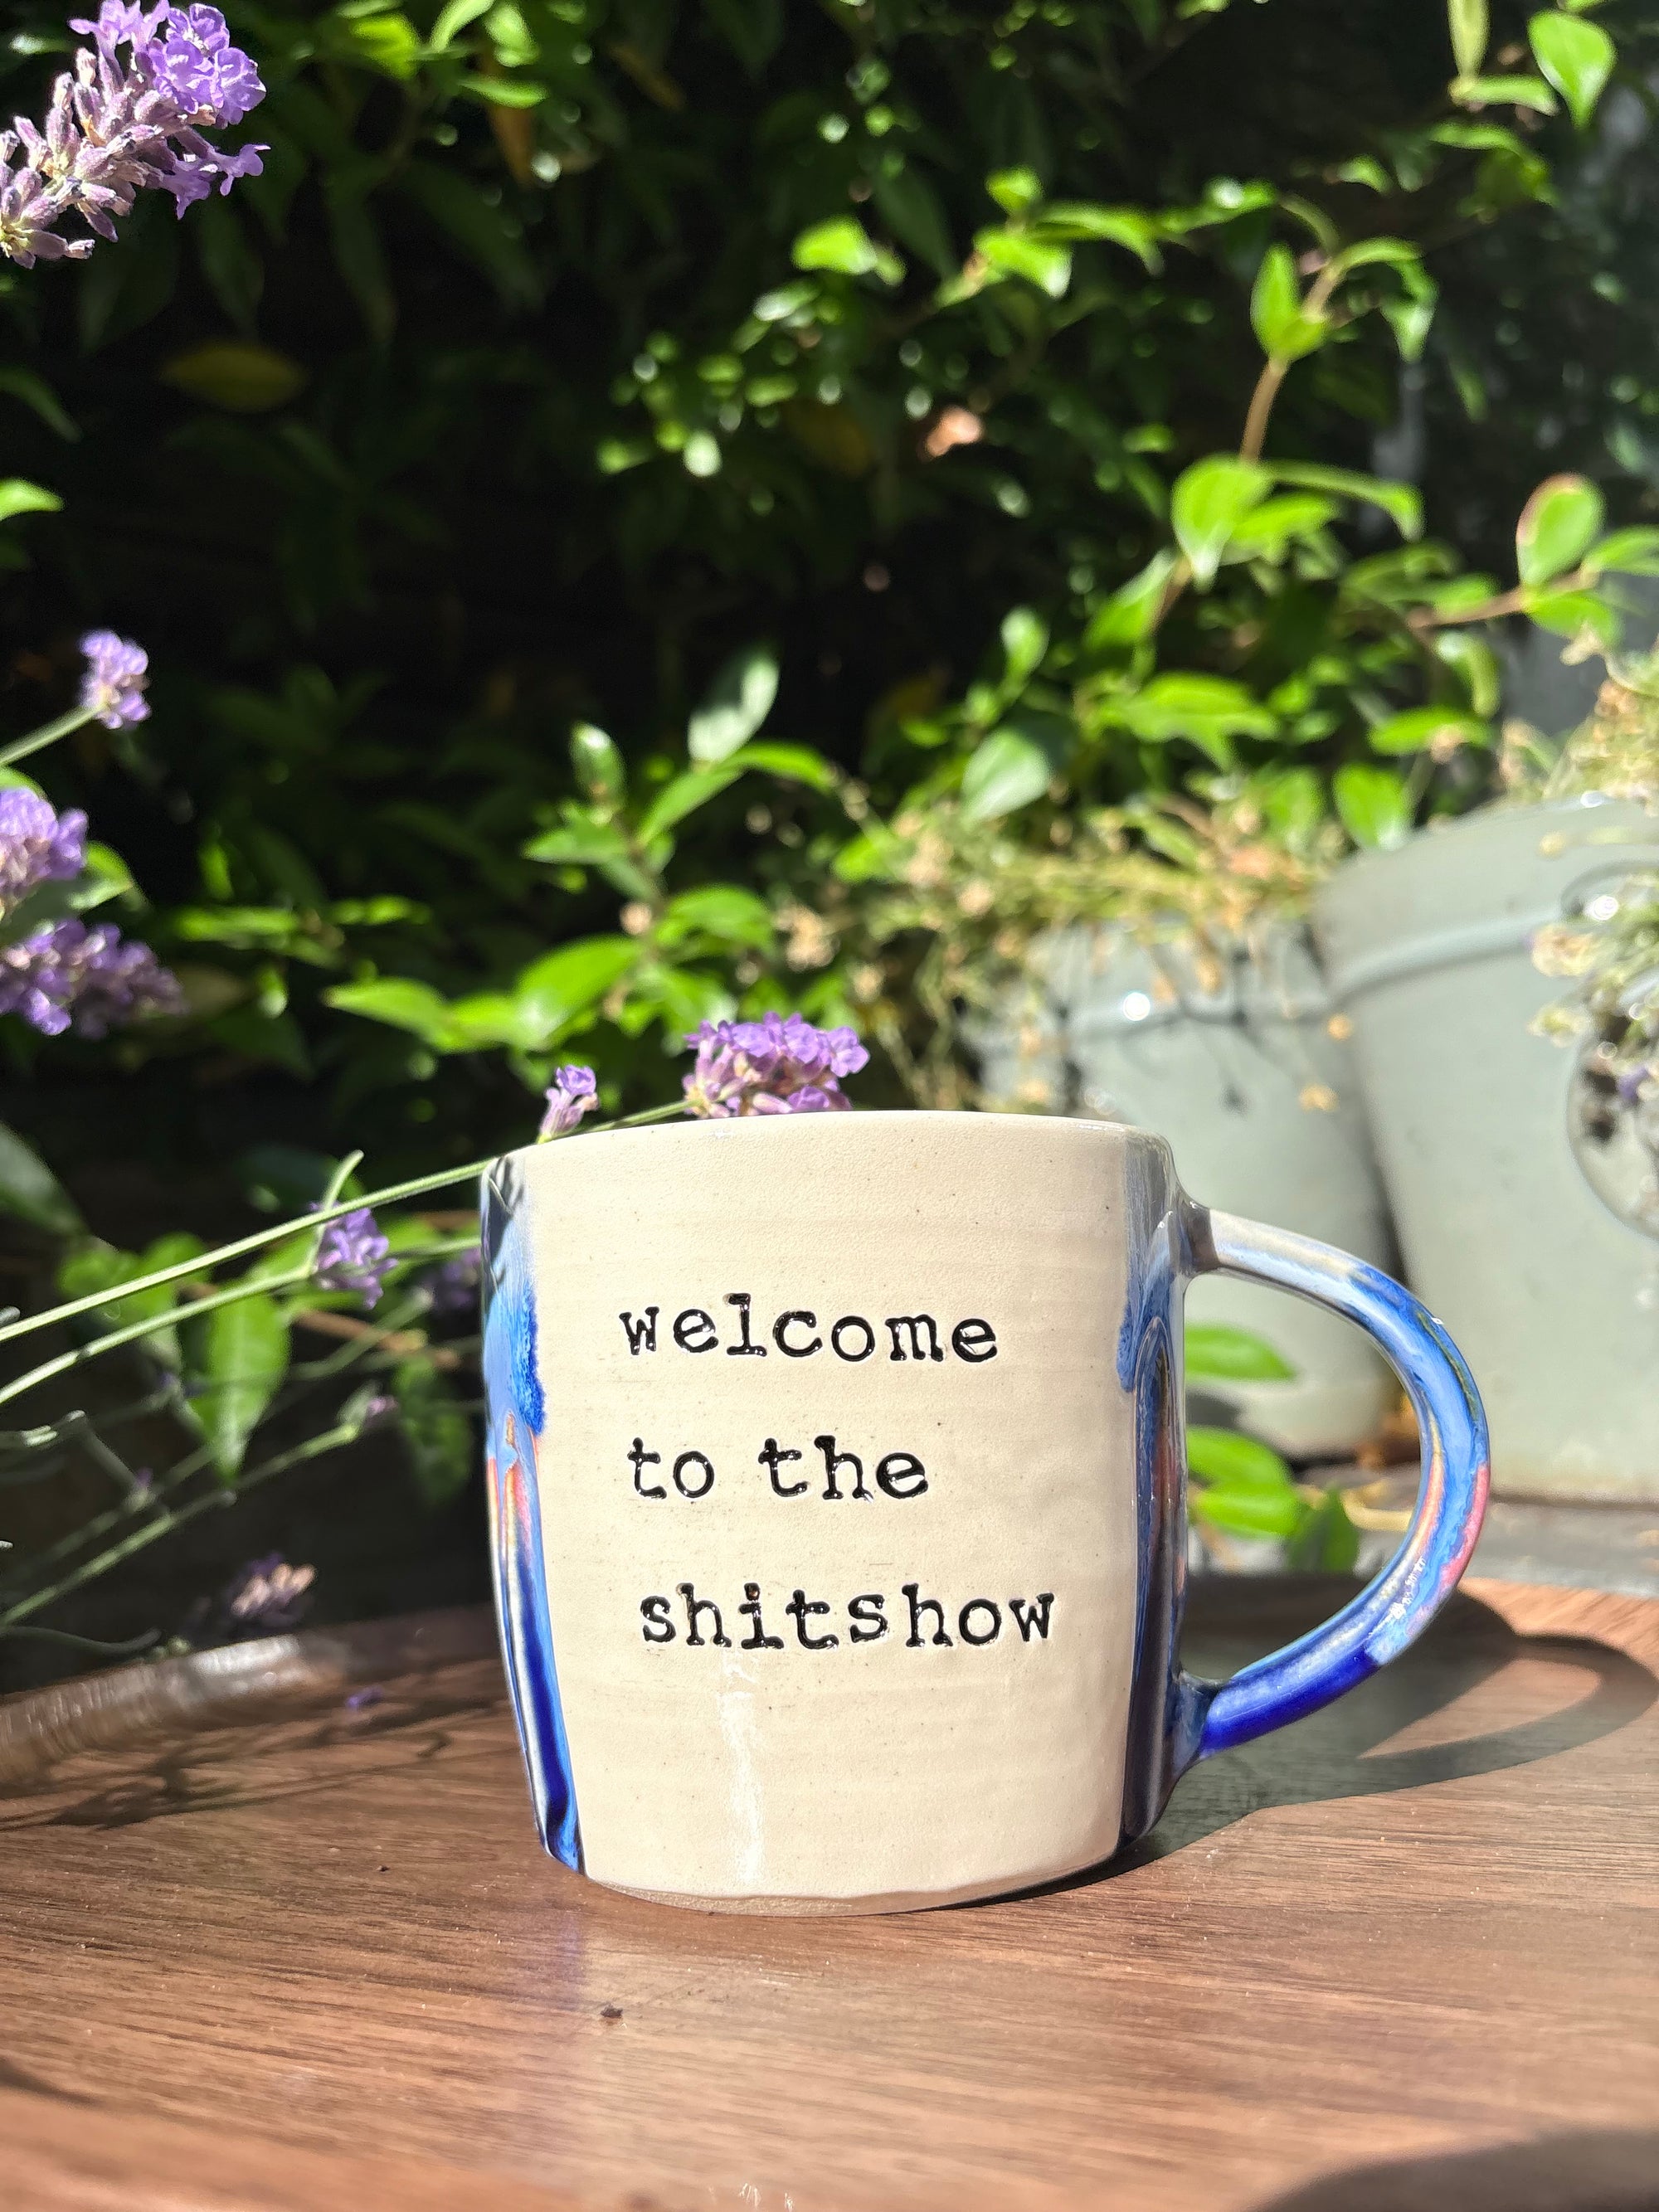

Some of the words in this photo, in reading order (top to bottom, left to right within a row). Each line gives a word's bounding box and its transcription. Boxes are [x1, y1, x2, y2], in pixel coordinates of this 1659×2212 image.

[619, 1292, 999, 1363] welcome
[626, 1437, 715, 1500] to
[757, 1435, 929, 1500] the
[640, 1582, 1054, 1650] shitshow
